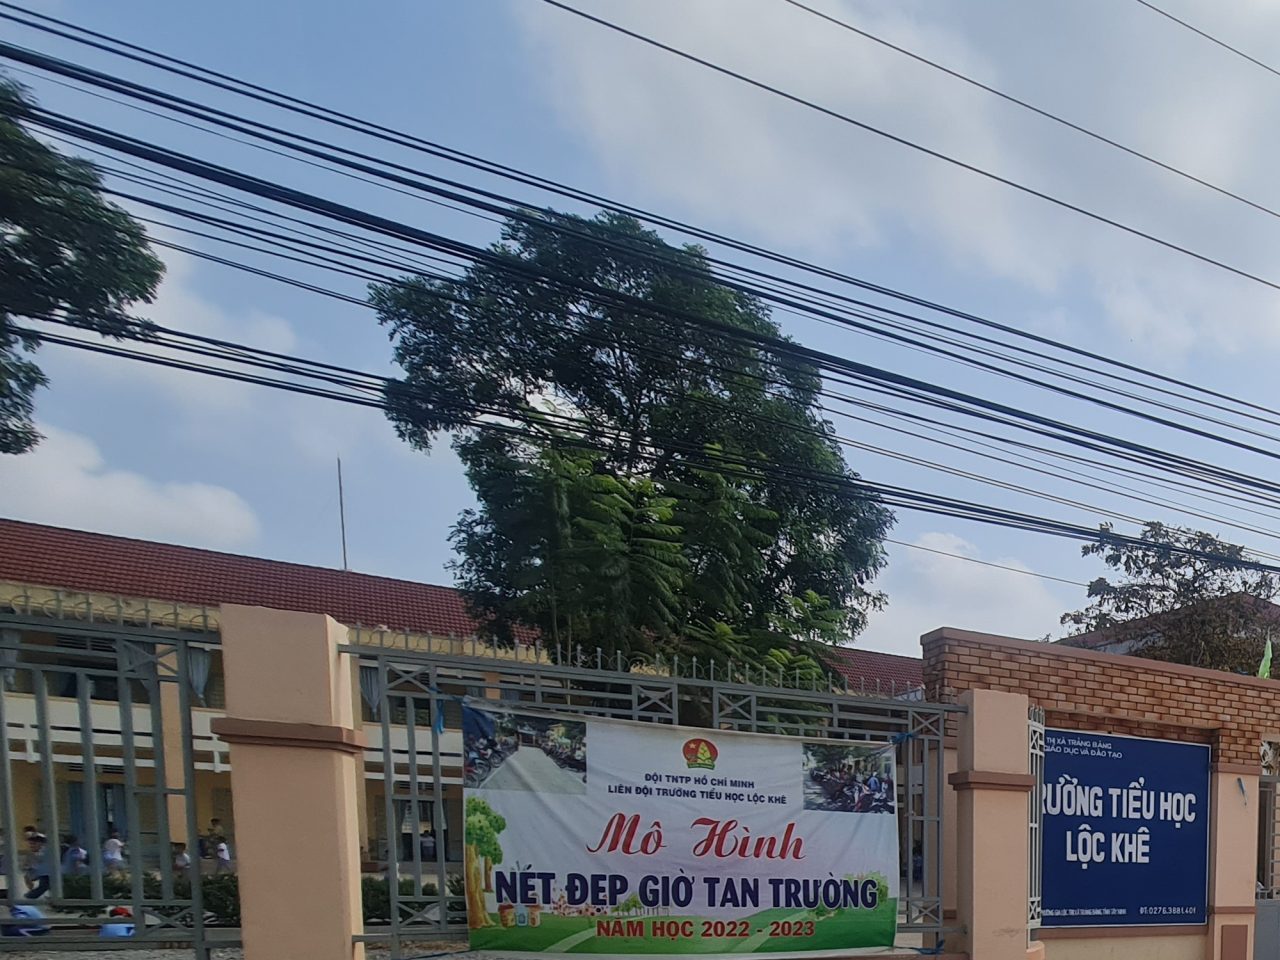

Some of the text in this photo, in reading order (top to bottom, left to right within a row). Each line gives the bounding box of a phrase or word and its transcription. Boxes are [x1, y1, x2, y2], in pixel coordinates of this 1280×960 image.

[608, 784, 632, 795] LIÊN
[635, 785, 652, 798] ĐỘI
[725, 792, 744, 804] HỌC
[747, 792, 765, 805] LỘC
[645, 772, 662, 782] ĐỘI
[665, 774, 691, 784] TNTP
[730, 779, 755, 789] MINH
[1042, 774, 1197, 829] ƯỜNG TIỂU HỌC
[586, 812, 806, 860] Mô Hình
[1066, 823, 1150, 869] LỘC KHÊ
[495, 864, 878, 913] NÉT ĐẸP GIỜ TAN TRƯỜNG
[596, 917, 644, 937] NĂM
[652, 920, 694, 940] HỌC
[701, 920, 750, 937] 2022
[769, 920, 815, 936] 2023
